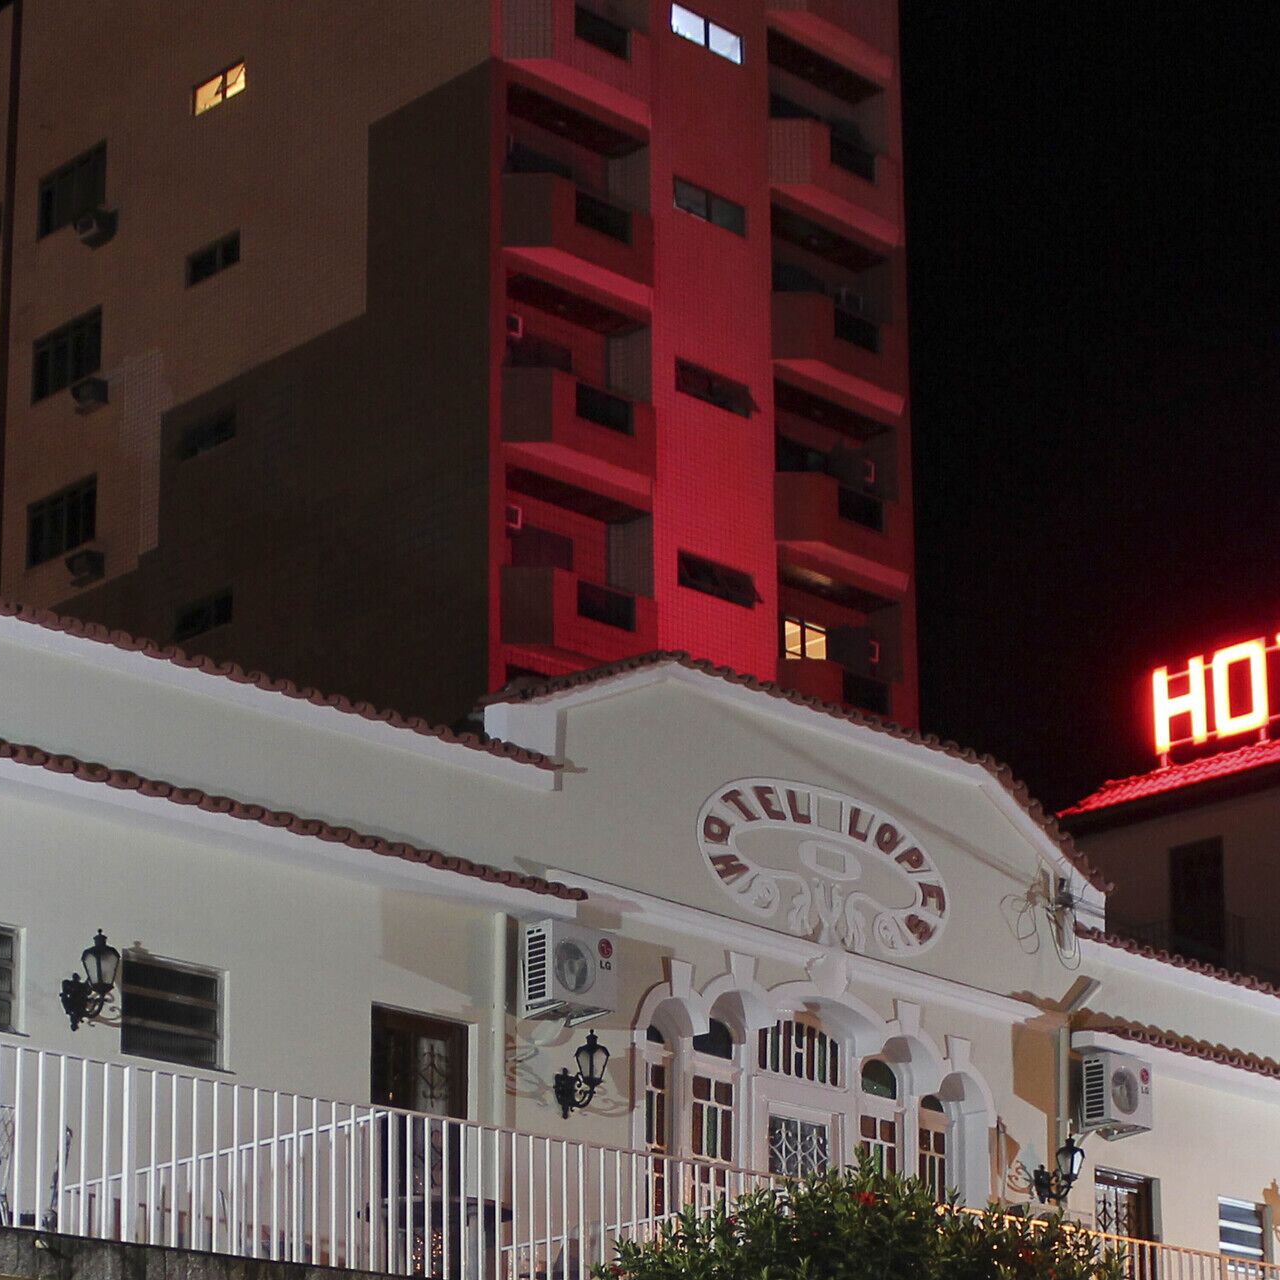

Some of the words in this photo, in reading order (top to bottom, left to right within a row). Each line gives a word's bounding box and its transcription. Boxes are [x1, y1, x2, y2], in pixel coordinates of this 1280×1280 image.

[703, 785, 812, 885] HOTEL
[847, 807, 946, 946] LOPES
[599, 959, 612, 971] LG
